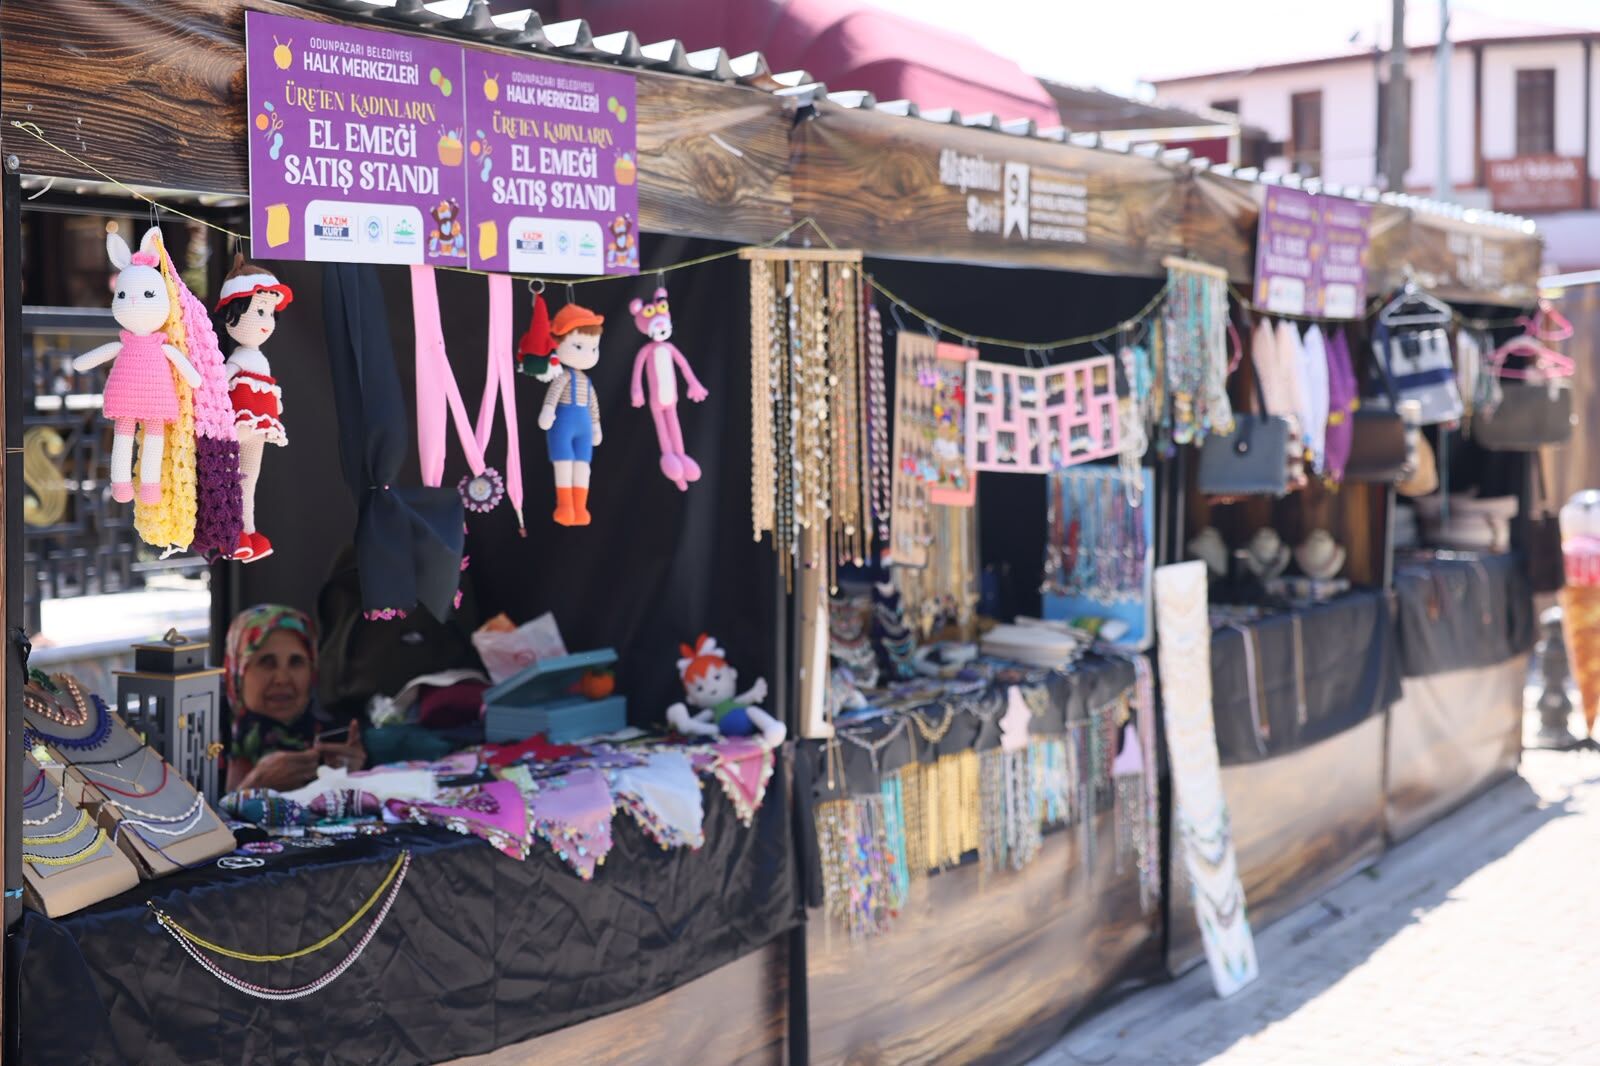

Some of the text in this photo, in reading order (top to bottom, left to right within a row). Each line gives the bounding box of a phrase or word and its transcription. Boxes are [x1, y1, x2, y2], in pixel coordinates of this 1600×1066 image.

[309, 37, 413, 63] ODUNPAZARI BELEDİYESİ
[303, 51, 420, 85] HALK MERKEZLERİ
[511, 71, 556, 88] ODUNPAZARI
[285, 80, 436, 125] ÜRETEN KADINLARIN
[506, 84, 600, 113] HALK MERKEZLERİ
[308, 118, 417, 158] EL EMEĞİ
[492, 109, 614, 149] ÜRETEN KADINLARIN
[284, 154, 440, 196] SATIŞ STANDI
[511, 144, 598, 179] EL EMEĞİ
[491, 176, 616, 213] SATIŞ STANDI
[321, 226, 343, 237] KURT
[322, 216, 348, 226] KAZIM
